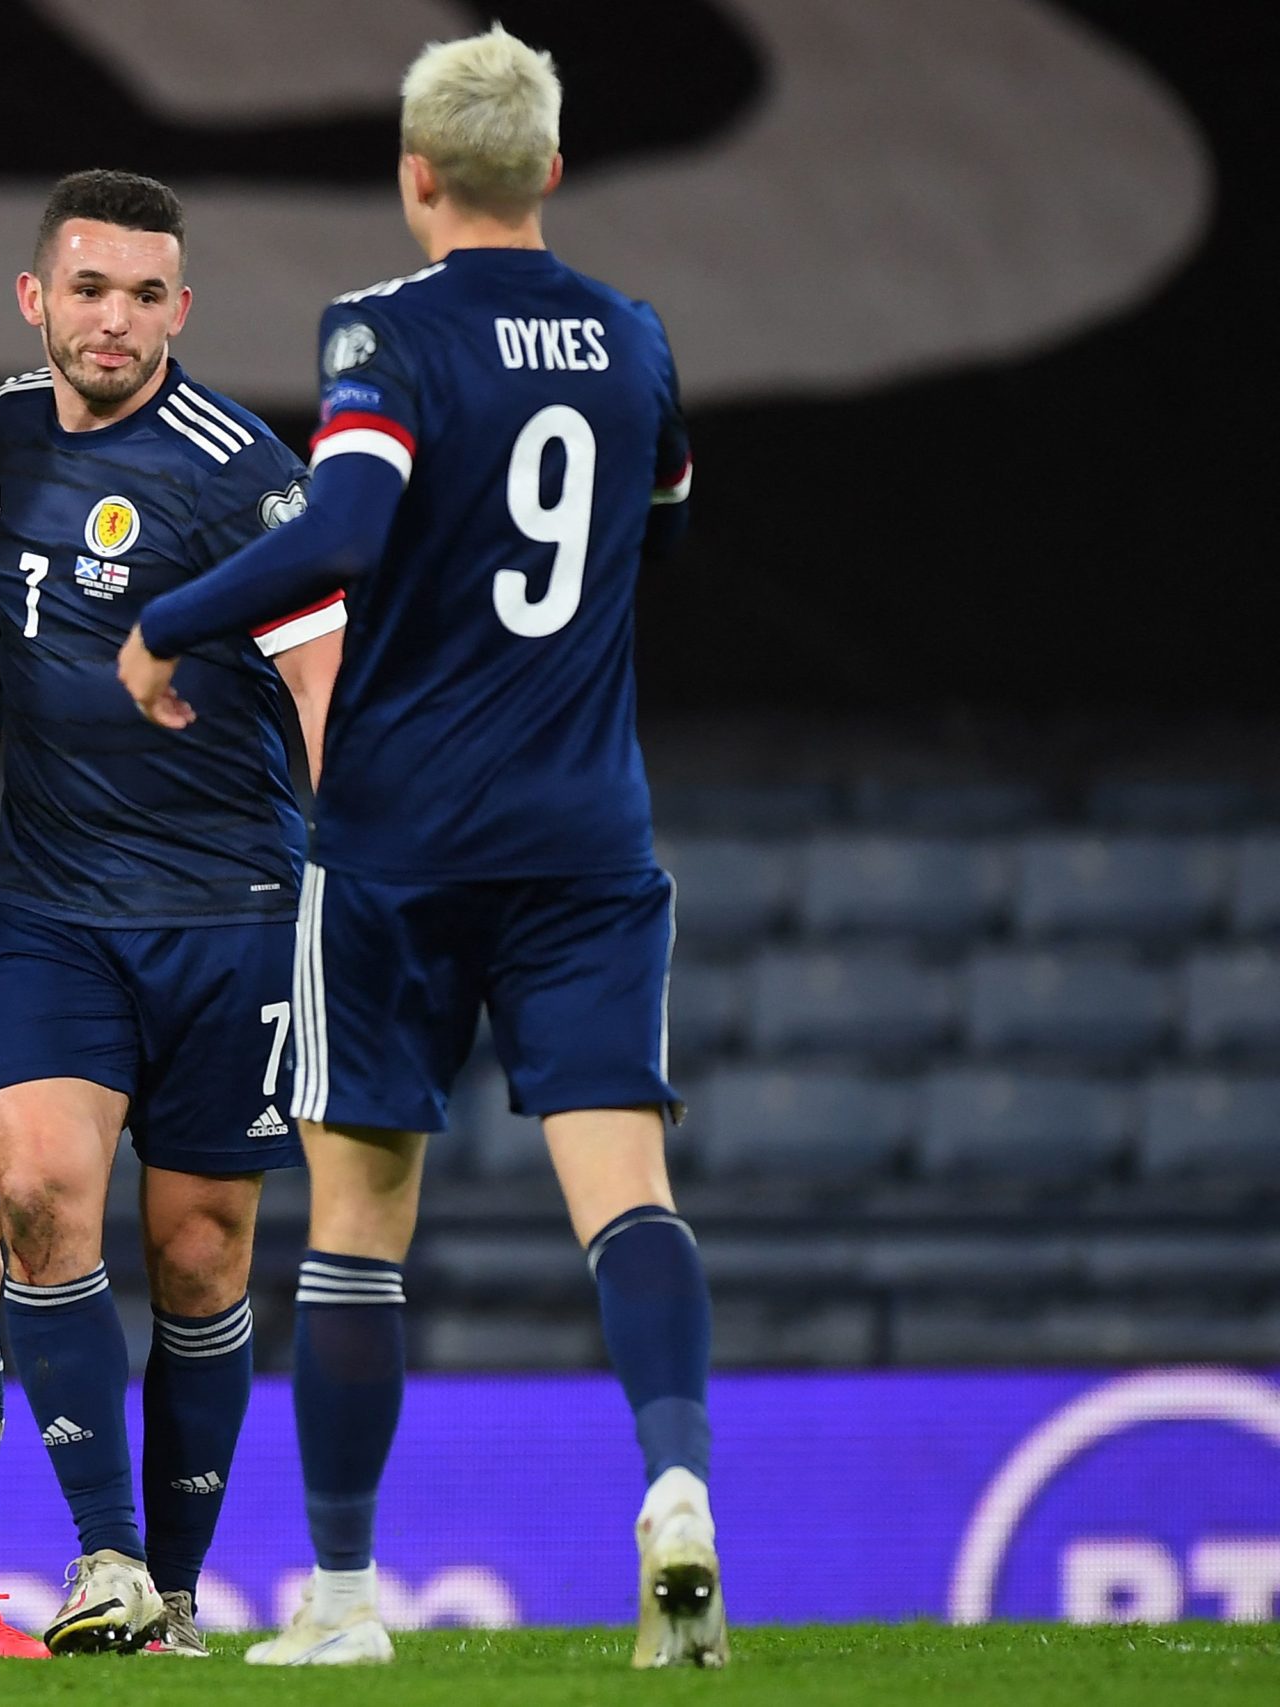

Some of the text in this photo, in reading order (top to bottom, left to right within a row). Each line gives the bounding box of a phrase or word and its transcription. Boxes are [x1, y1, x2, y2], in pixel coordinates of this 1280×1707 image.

[494, 317, 610, 372] DYKES
[492, 403, 597, 639] 9
[19, 552, 50, 638] 7
[261, 1001, 291, 1096] 7
[246, 1124, 289, 1138] adidas
[43, 1430, 94, 1446] didas
